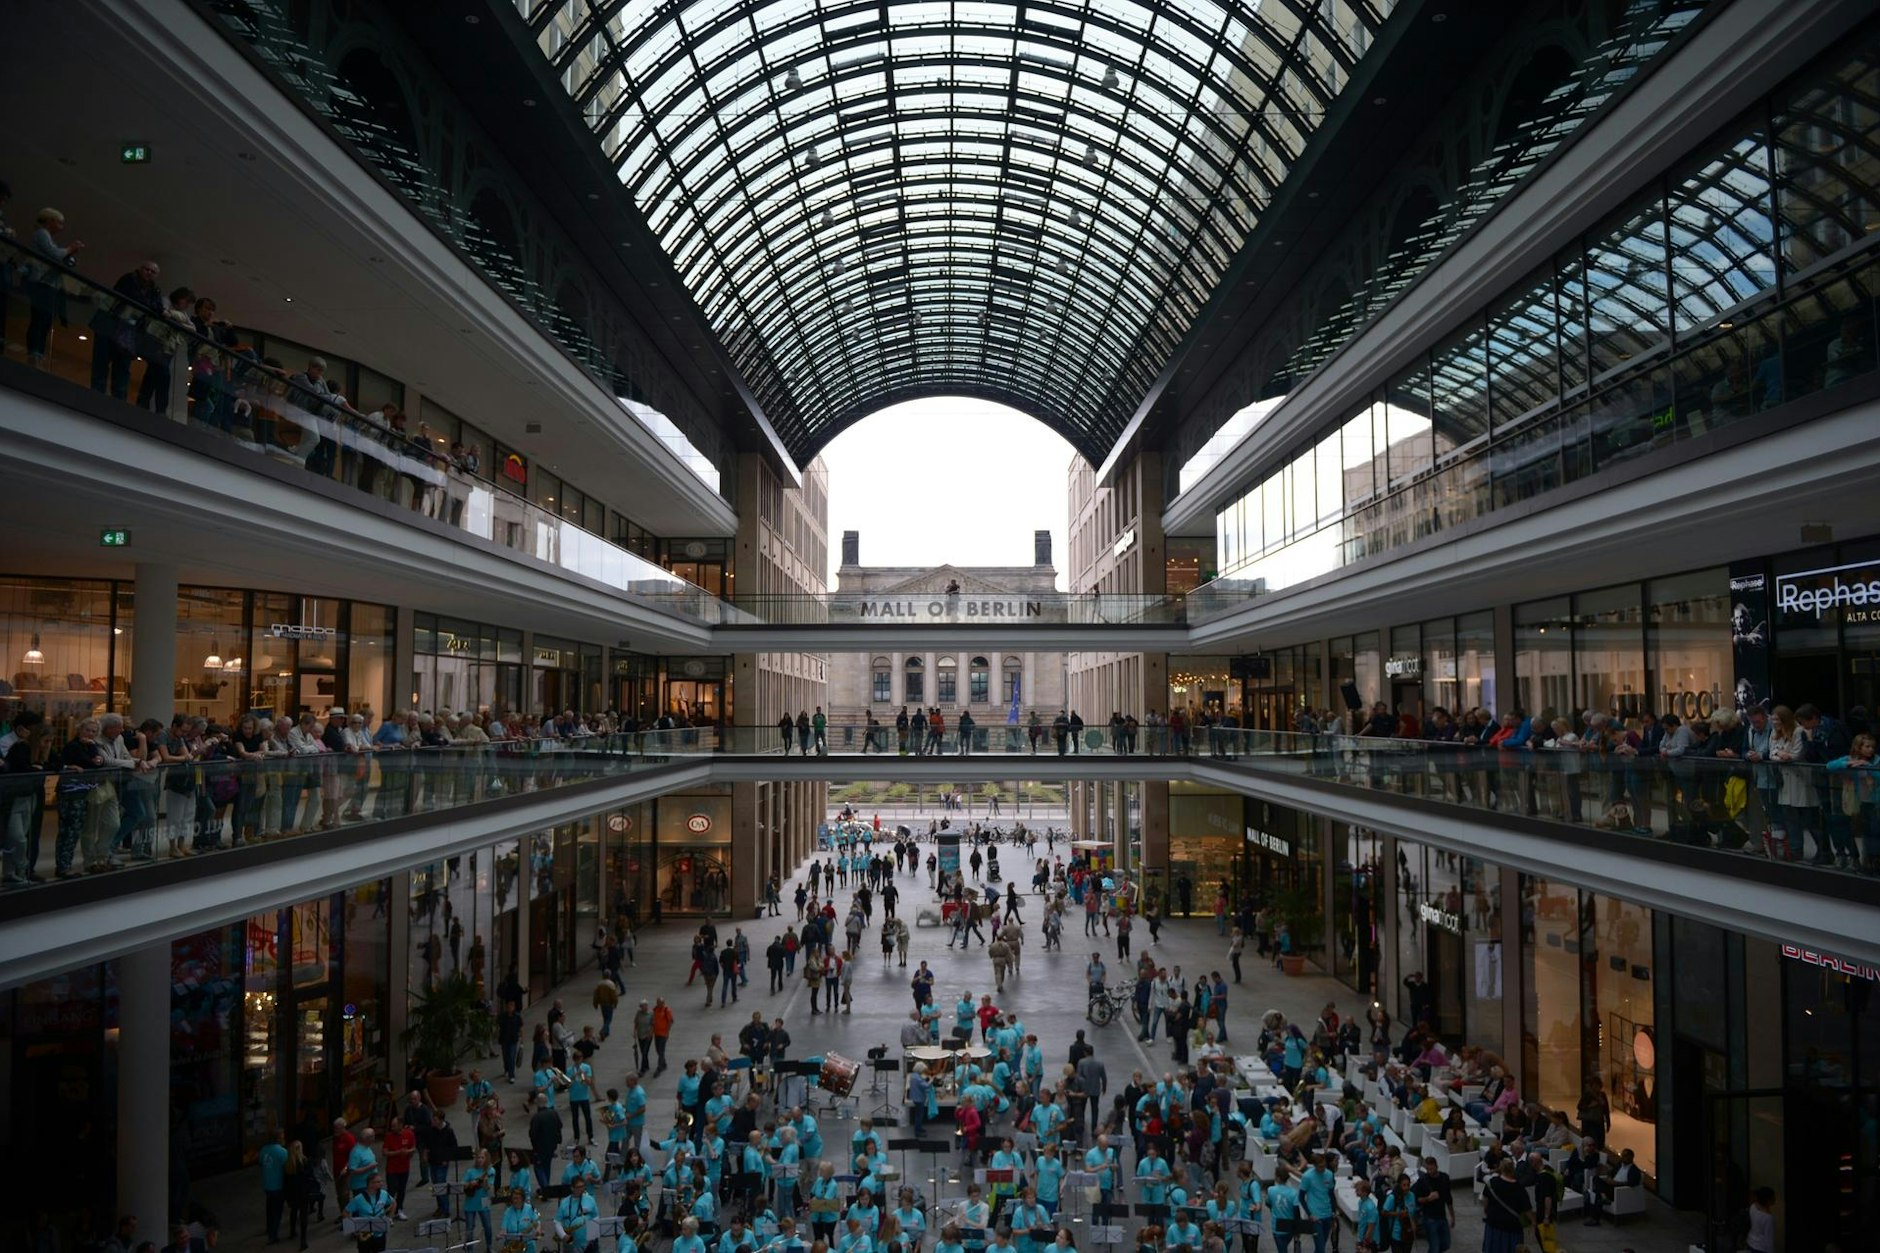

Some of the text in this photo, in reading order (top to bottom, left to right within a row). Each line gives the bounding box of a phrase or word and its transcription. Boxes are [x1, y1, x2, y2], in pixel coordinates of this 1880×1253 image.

[861, 602, 916, 617] MALL
[967, 602, 1041, 617] BERLIN
[1847, 612, 1867, 623] ALTA
